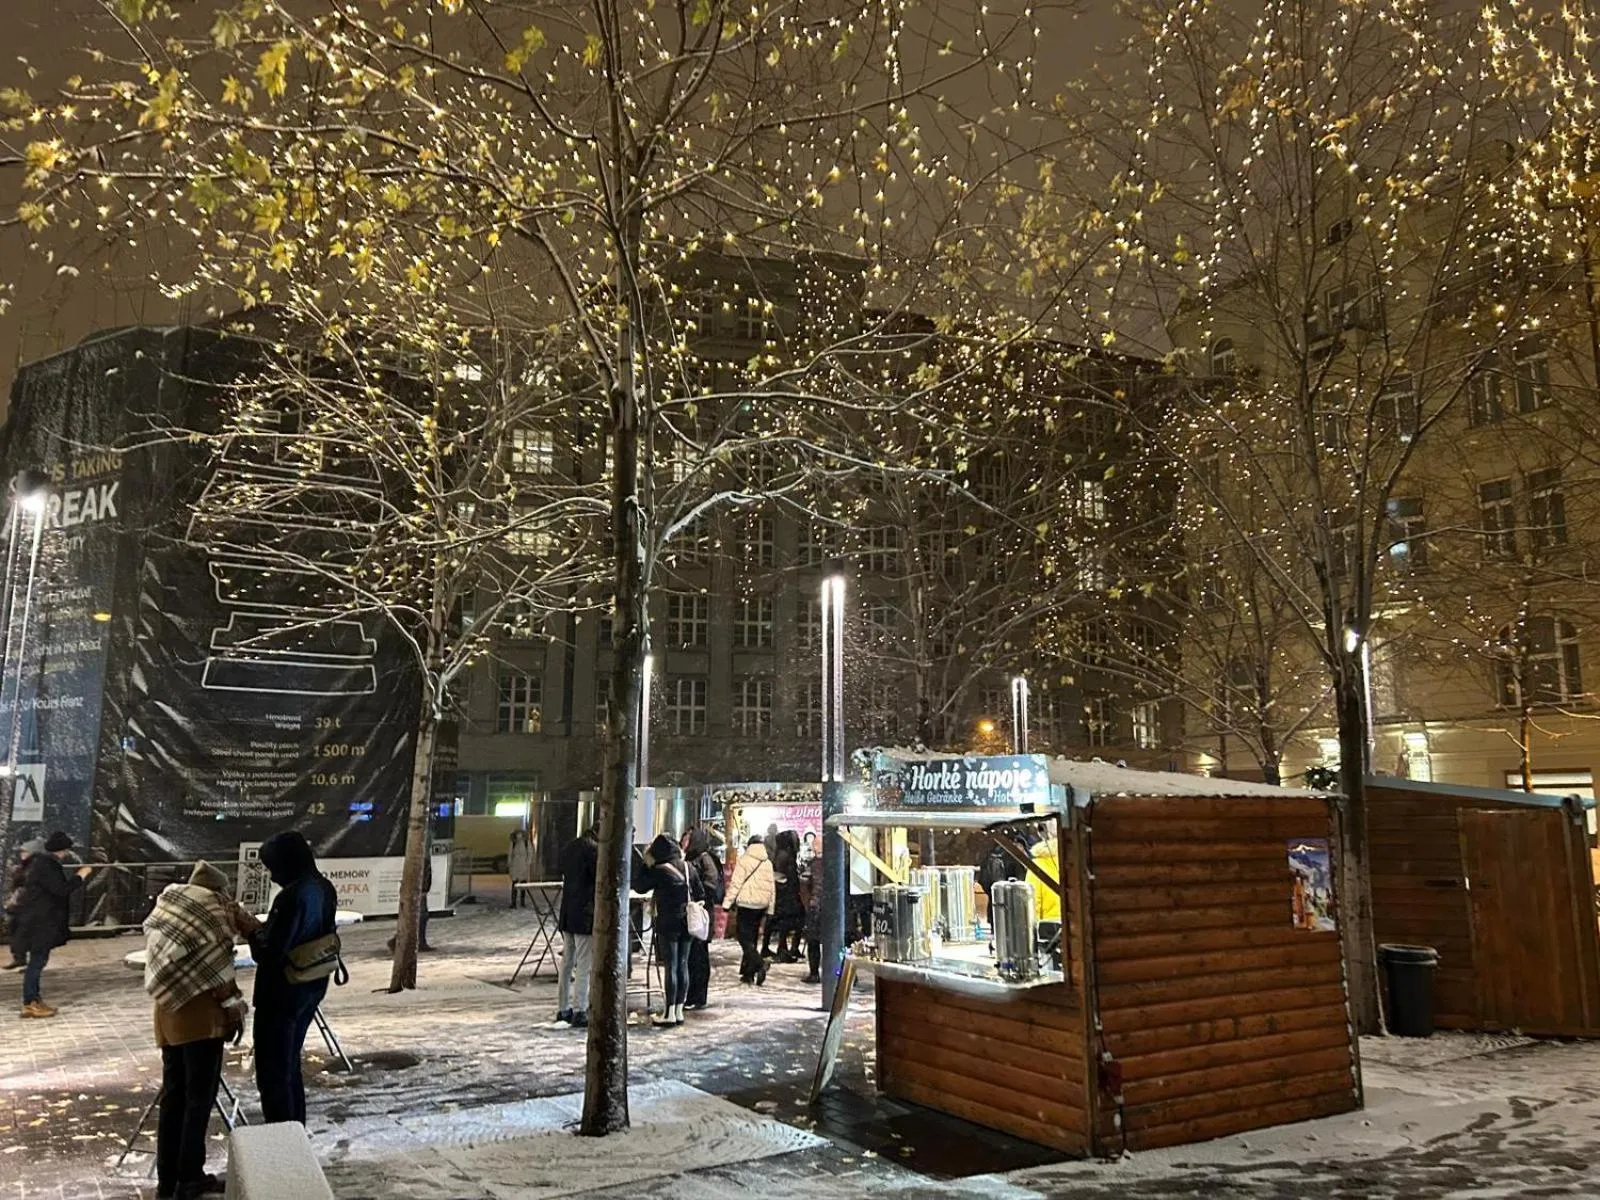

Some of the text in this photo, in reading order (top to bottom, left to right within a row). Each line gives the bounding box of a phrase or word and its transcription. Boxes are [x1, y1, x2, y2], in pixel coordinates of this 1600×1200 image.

[72, 455, 122, 478] TAKING
[44, 481, 119, 530] REAK
[315, 717, 332, 729] 39
[351, 745, 366, 757] m
[340, 775, 356, 786] m
[911, 762, 961, 790] Horké
[965, 761, 1032, 798] nápoje
[926, 791, 963, 804] Getränke
[307, 802, 326, 816] 42
[330, 870, 370, 879] MEMORY
